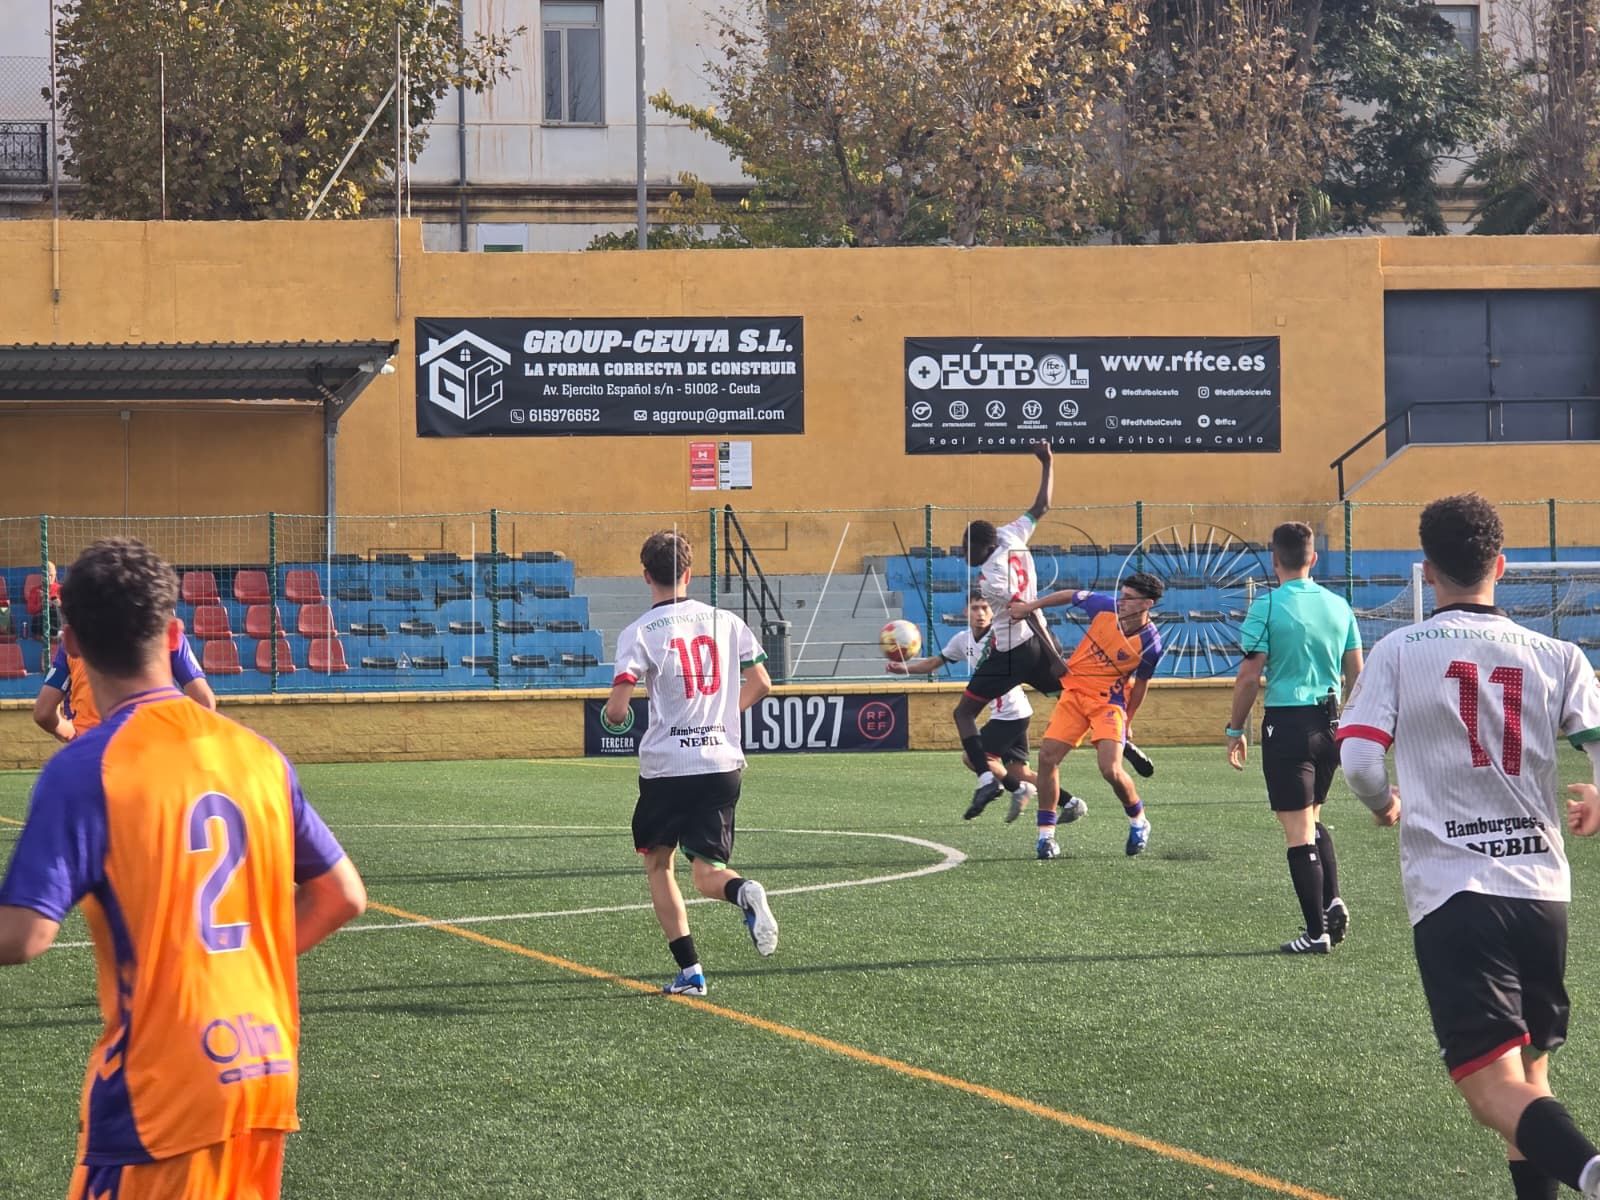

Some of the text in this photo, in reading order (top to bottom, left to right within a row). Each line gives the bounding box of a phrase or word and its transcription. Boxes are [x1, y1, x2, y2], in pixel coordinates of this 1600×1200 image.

[523, 329, 794, 354] GROUP-CEUTA S.L.
[524, 361, 797, 377] LA FORMA CORRECTA DE CONSTRUIR
[1100, 350, 1266, 372] www.rffce.es
[543, 384, 559, 395] Av.
[562, 383, 604, 397] Ejercito
[607, 383, 651, 398] Español
[654, 383, 674, 396] s/n
[684, 383, 719, 395] 51002
[729, 382, 761, 395] Ceuta
[529, 409, 601, 423] 615976652
[652, 408, 785, 424] aggroup@gmail.com
[929, 435, 966, 446] Real
[1088, 434, 1106, 445] de
[1118, 434, 1173, 445] Fútbol
[1184, 434, 1203, 445] de
[1214, 434, 1264, 445] Ceuta
[1405, 627, 1496, 643] SPORTING
[669, 635, 721, 699] 10
[1445, 660, 1524, 777] 11
[600, 737, 634, 749] TERCERA
[188, 791, 252, 954] 2
